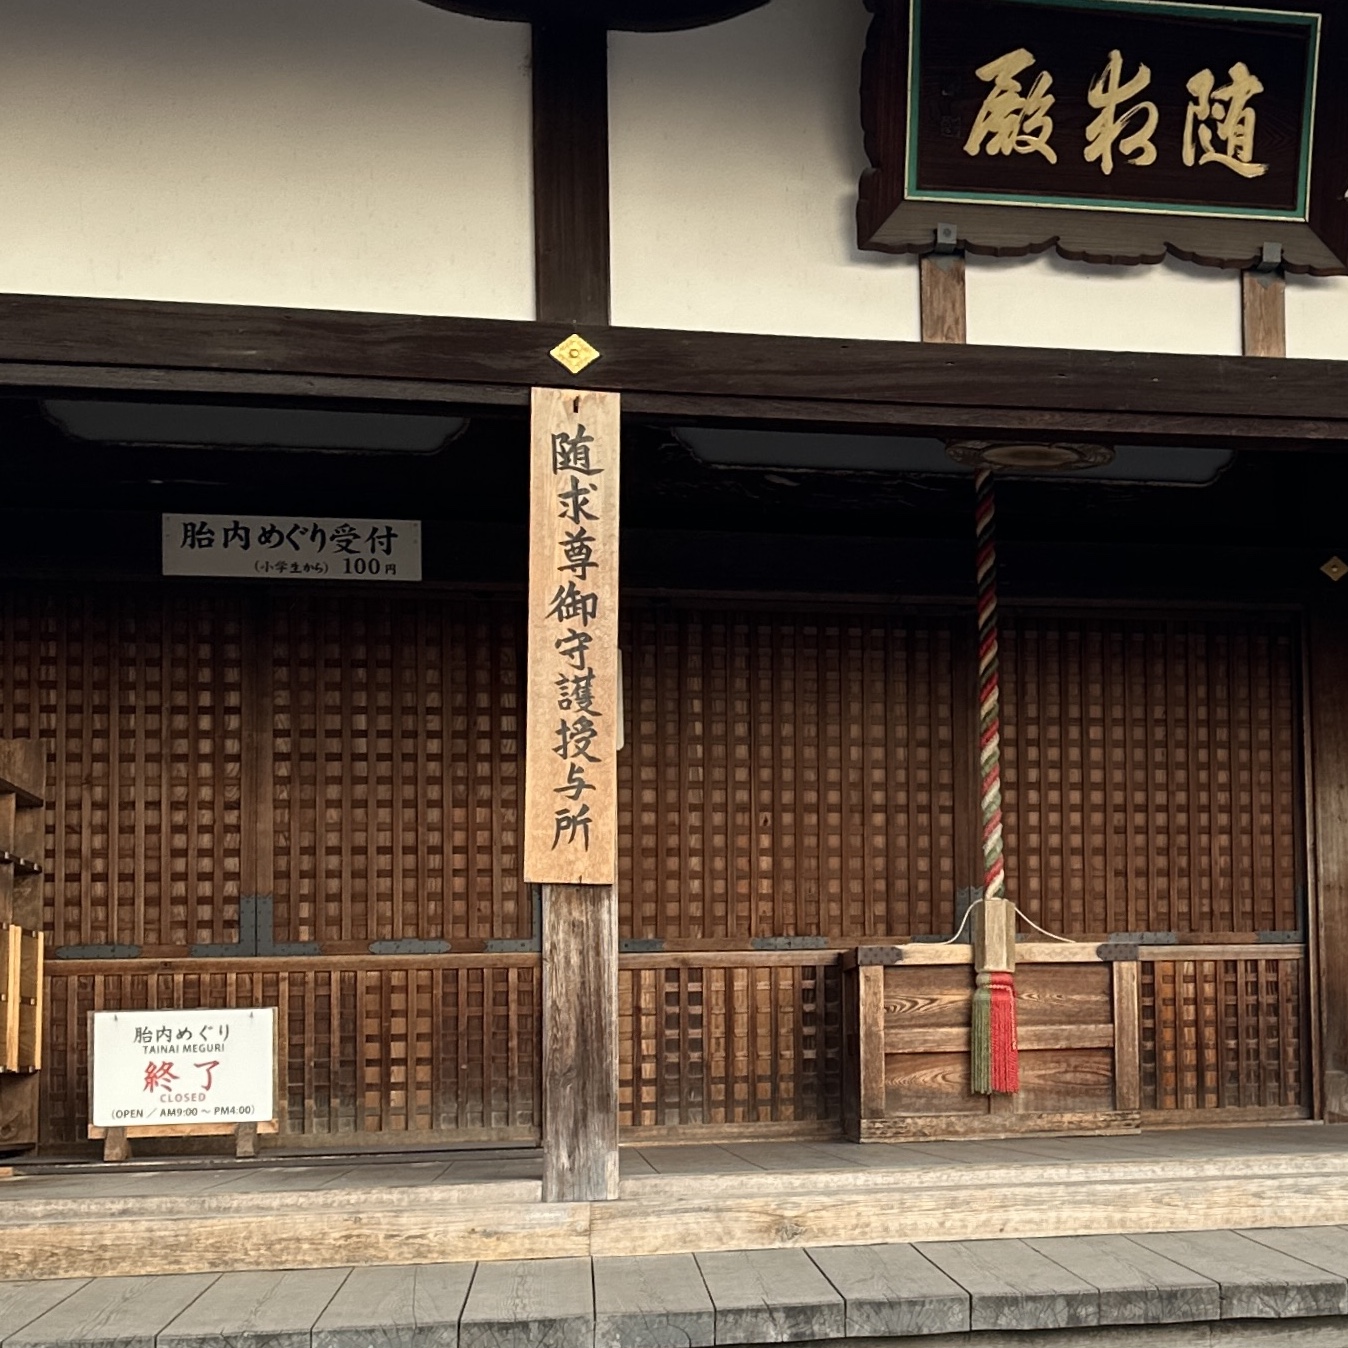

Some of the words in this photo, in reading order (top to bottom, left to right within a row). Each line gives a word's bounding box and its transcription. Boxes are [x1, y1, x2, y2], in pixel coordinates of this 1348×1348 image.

[180, 520, 399, 556] 胎内めぐり受付
[545, 423, 604, 851] 随求尊御守護授与所
[133, 1024, 230, 1043] 胎内めぐり
[142, 1044, 180, 1055] TAINAI
[182, 1043, 225, 1053] MEGURI
[143, 1060, 220, 1093] 終了
[160, 1093, 206, 1103] CLOSED
[160, 1107, 198, 1118] AM9:00
